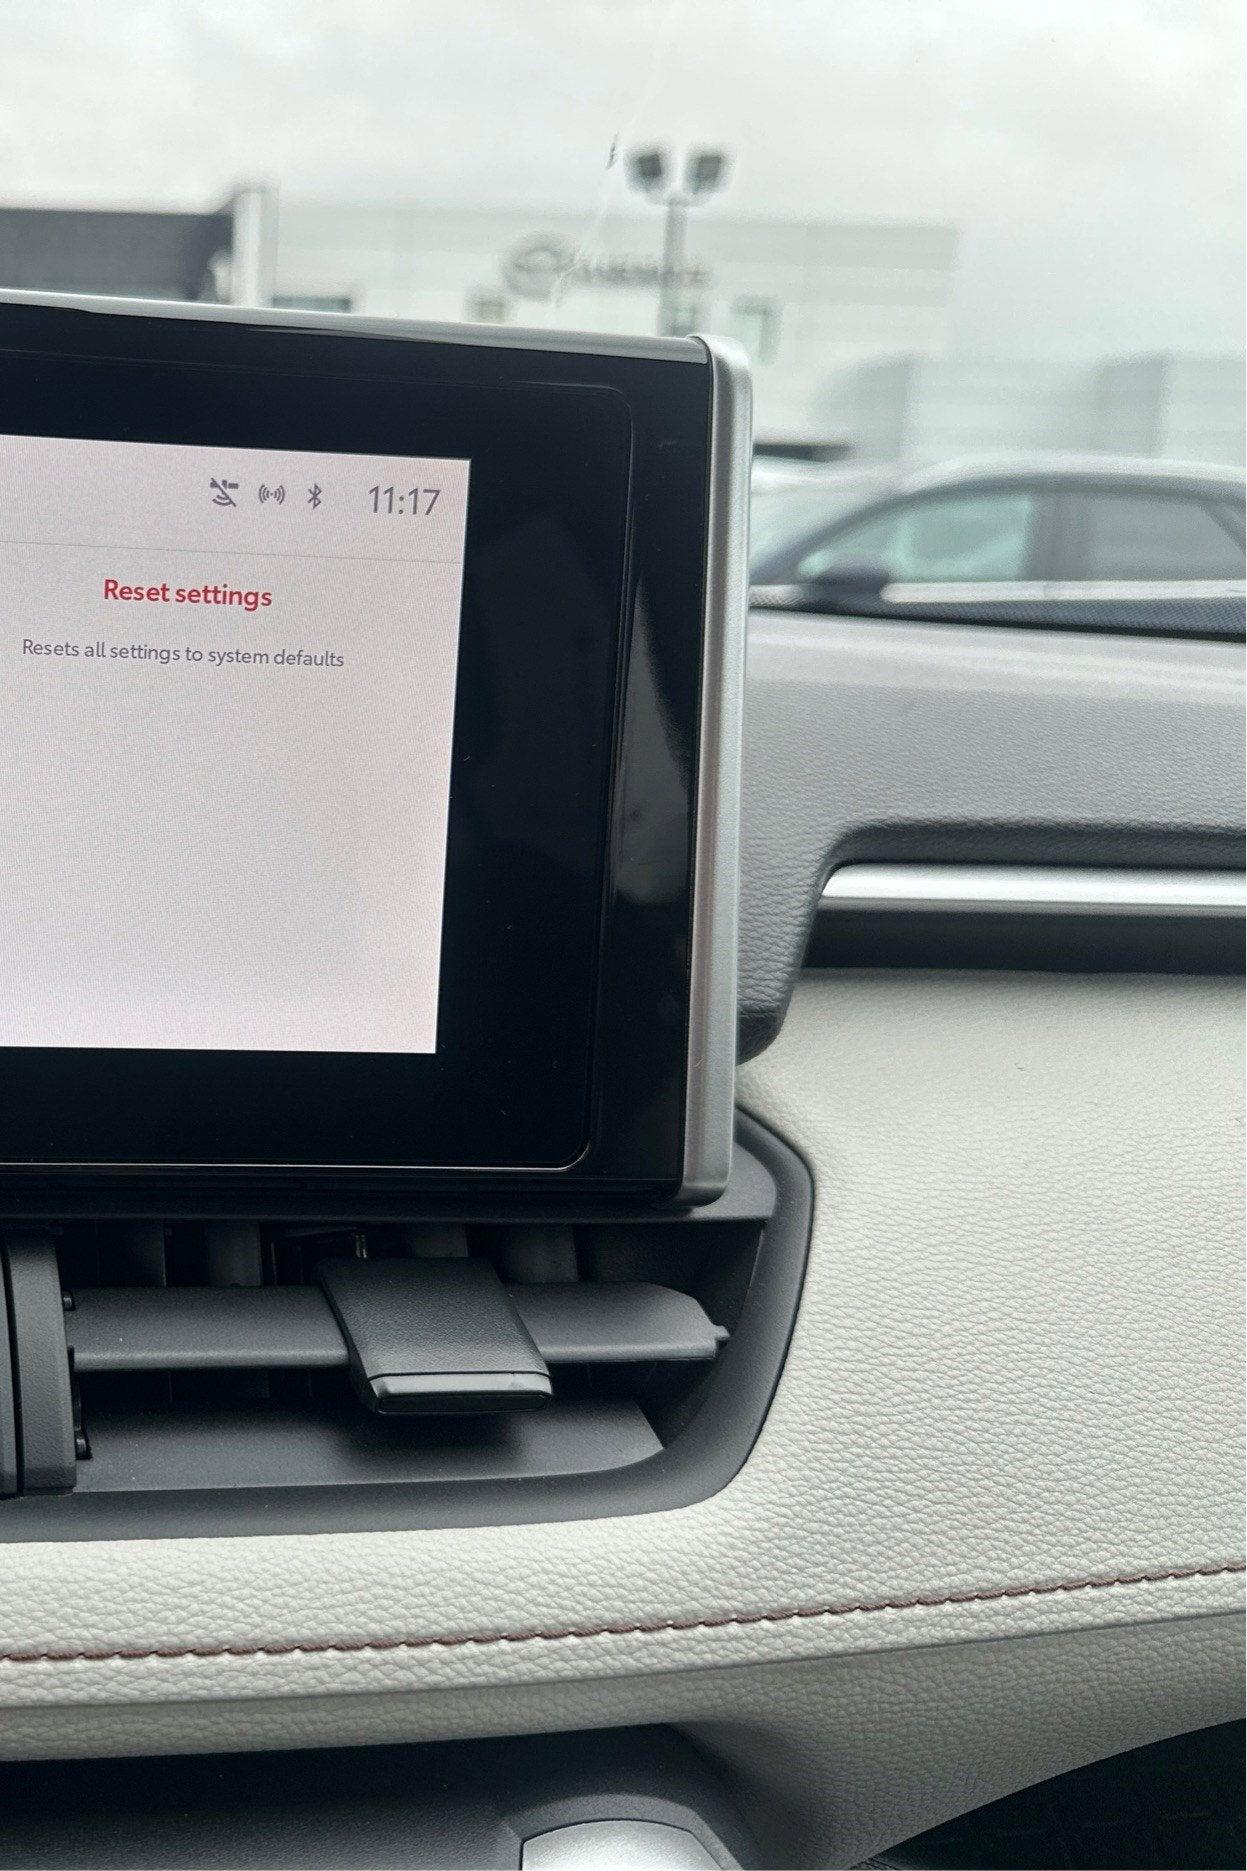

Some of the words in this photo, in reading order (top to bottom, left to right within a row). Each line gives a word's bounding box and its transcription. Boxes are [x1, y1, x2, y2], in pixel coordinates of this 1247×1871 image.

[368, 485, 441, 517] 11:17
[104, 578, 170, 604] Reset
[174, 583, 272, 611] settings
[22, 638, 80, 658] Resets
[84, 641, 107, 659] all
[109, 643, 181, 665] settings
[184, 646, 204, 663] to
[208, 648, 270, 668] system
[273, 648, 345, 668] defaults
